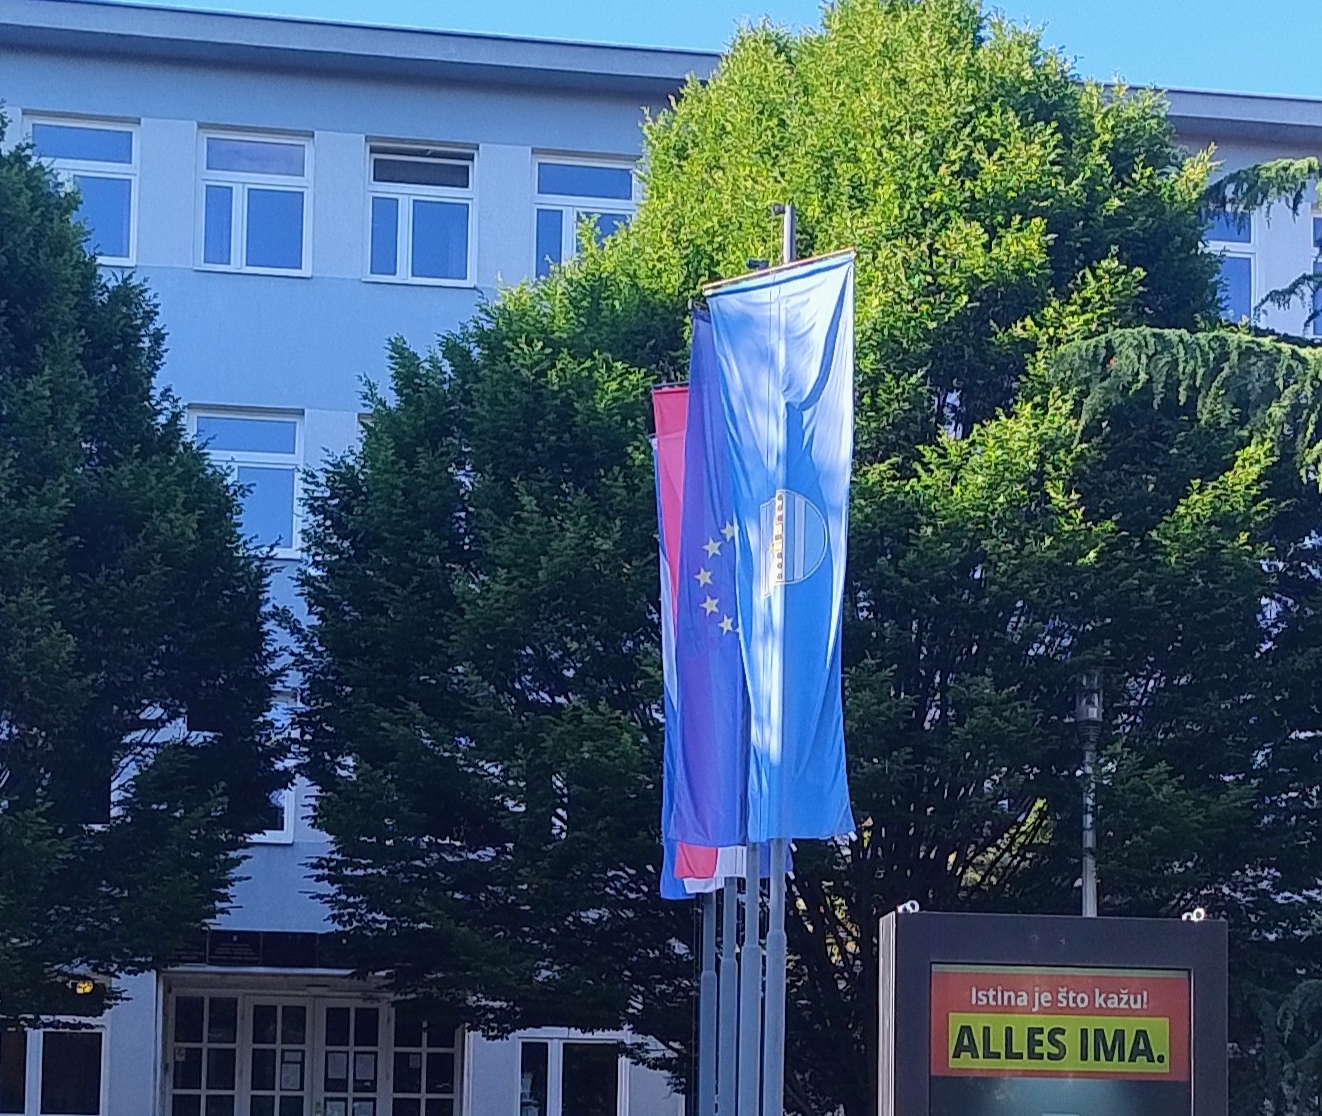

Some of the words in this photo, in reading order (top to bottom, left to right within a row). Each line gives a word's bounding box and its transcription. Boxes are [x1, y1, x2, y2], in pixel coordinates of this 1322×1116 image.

[971, 986, 1028, 1006] Istina
[1031, 987, 1053, 1012] je
[1057, 987, 1089, 1008] što
[1094, 988, 1148, 1009] kažu!
[952, 1025, 1067, 1061] ALLES
[1080, 1027, 1165, 1063] IMA.
